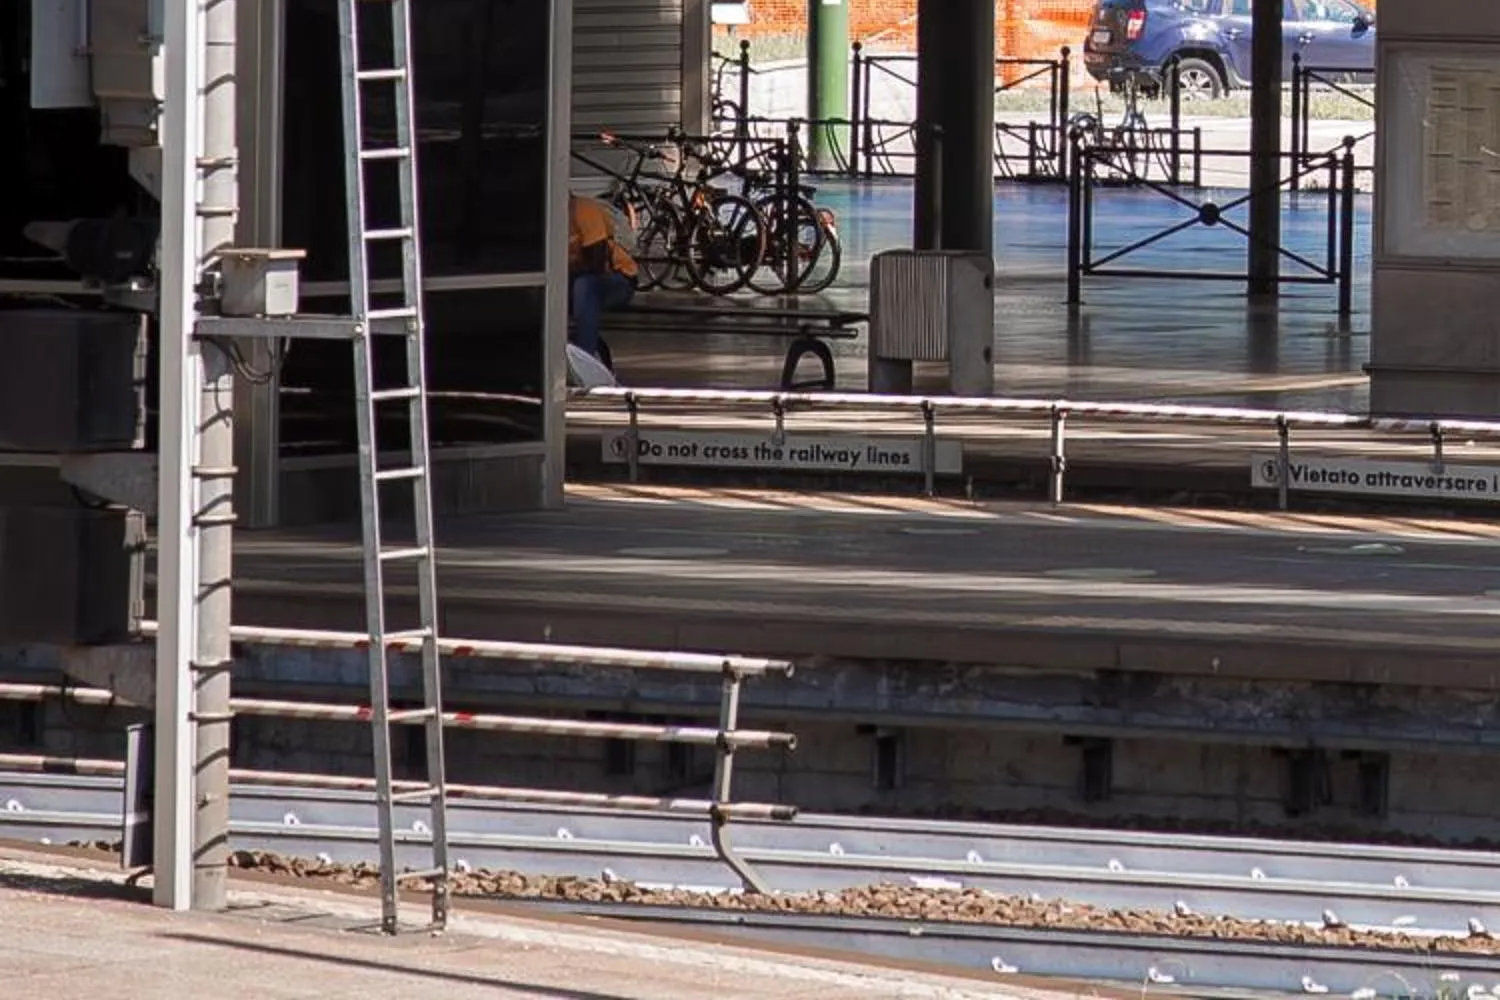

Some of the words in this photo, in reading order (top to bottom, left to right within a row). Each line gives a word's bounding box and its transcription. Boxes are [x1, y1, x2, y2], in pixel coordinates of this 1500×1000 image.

[637, 438, 662, 457] Do
[667, 442, 698, 459] not
[703, 446, 748, 461] cross
[753, 443, 783, 462] the
[788, 445, 861, 467] railway
[866, 446, 910, 466] lines
[1288, 464, 1360, 486] Vietato
[1365, 472, 1488, 493] attraversare
